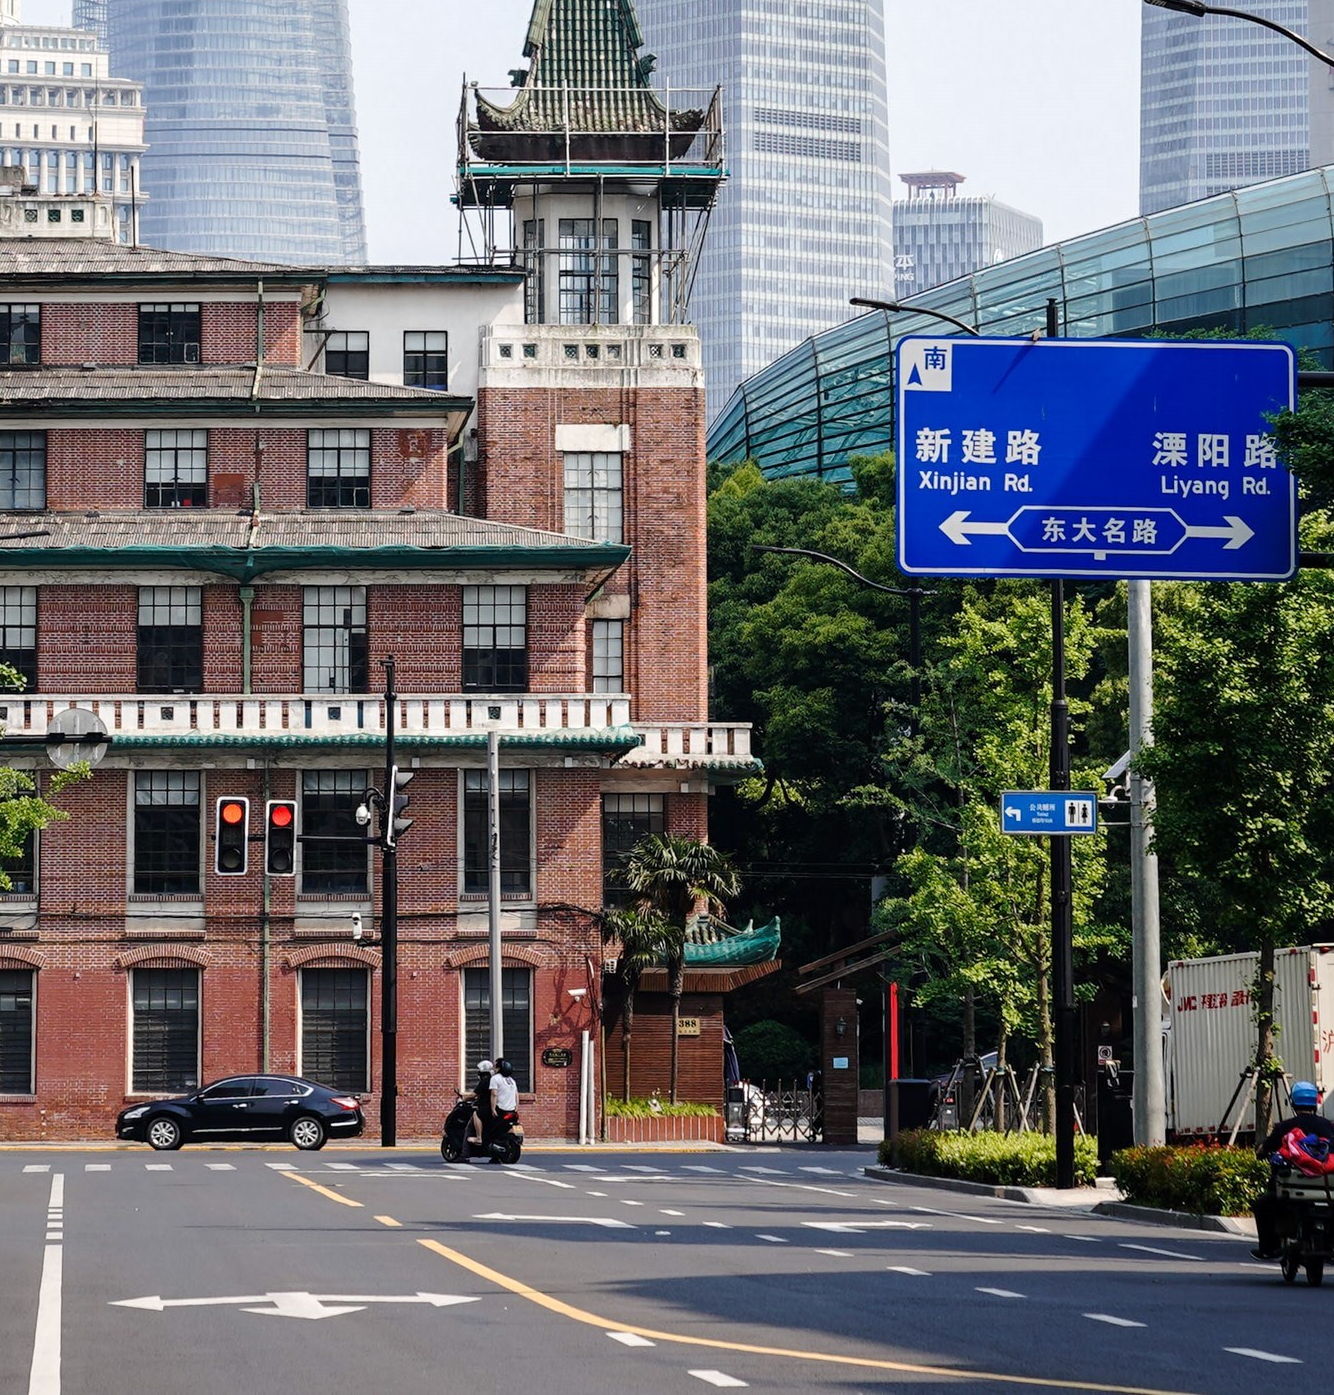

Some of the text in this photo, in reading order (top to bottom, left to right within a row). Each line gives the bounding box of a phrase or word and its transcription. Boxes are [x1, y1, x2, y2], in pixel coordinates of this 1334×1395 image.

[924, 346, 948, 370] 南
[915, 427, 1042, 466] 新建路
[1152, 431, 1278, 469] 溧阳路
[918, 471, 1034, 495] Xinjian Rd.
[1161, 476, 1271, 500] Liyang Rd.
[1041, 517, 1158, 544] 东大名路
